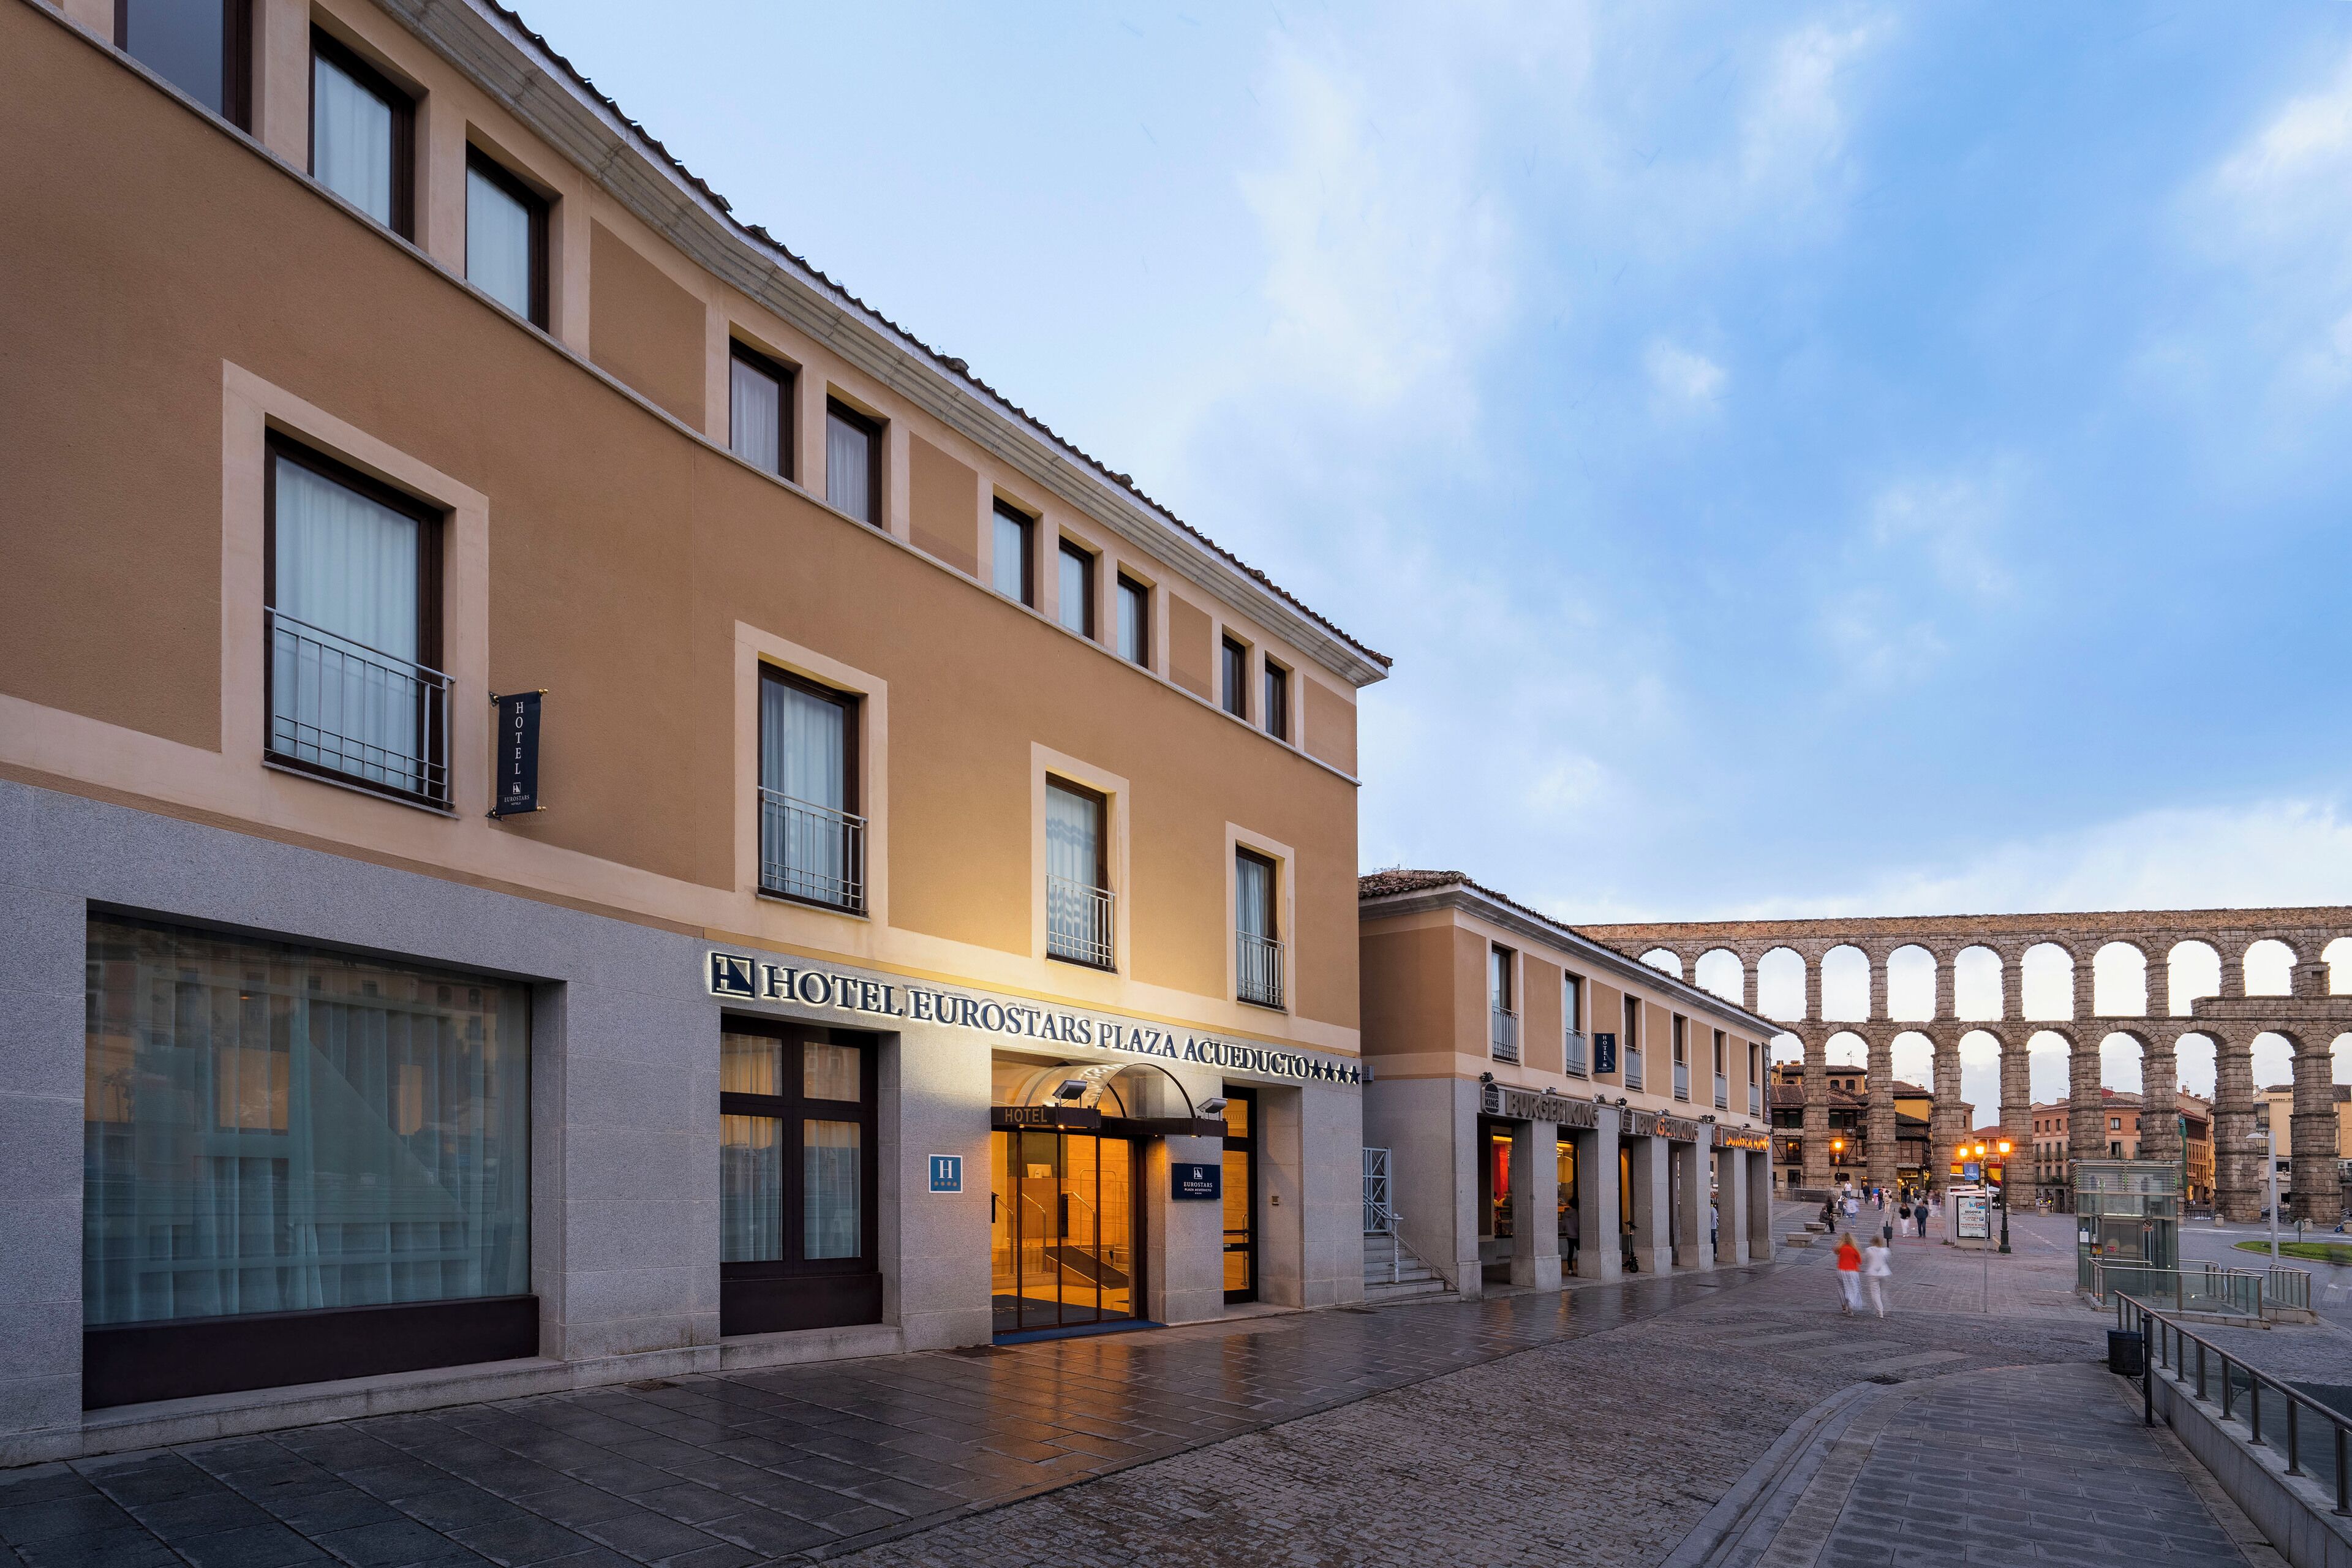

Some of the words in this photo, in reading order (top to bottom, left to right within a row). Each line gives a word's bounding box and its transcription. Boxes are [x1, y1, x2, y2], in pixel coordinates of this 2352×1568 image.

[515, 701, 524, 775] HOTEL
[762, 963, 903, 1016] HOTEL
[910, 990, 1091, 1044] EUROSTARS
[1096, 1022, 1178, 1058] PLAZA
[1182, 1038, 1310, 1078] ACUEDUCTO
[1005, 1107, 1047, 1123] HOTEL
[1485, 1098, 1499, 1108] KING
[1506, 1090, 1565, 1121] BURGER
[1566, 1100, 1599, 1127] KING
[1635, 1113, 1676, 1137] BURGER
[1676, 1120, 1699, 1141] KING
[1724, 1129, 1753, 1149] BURGER
[1754, 1134, 1770, 1151] KING
[938, 1160, 953, 1178] H
